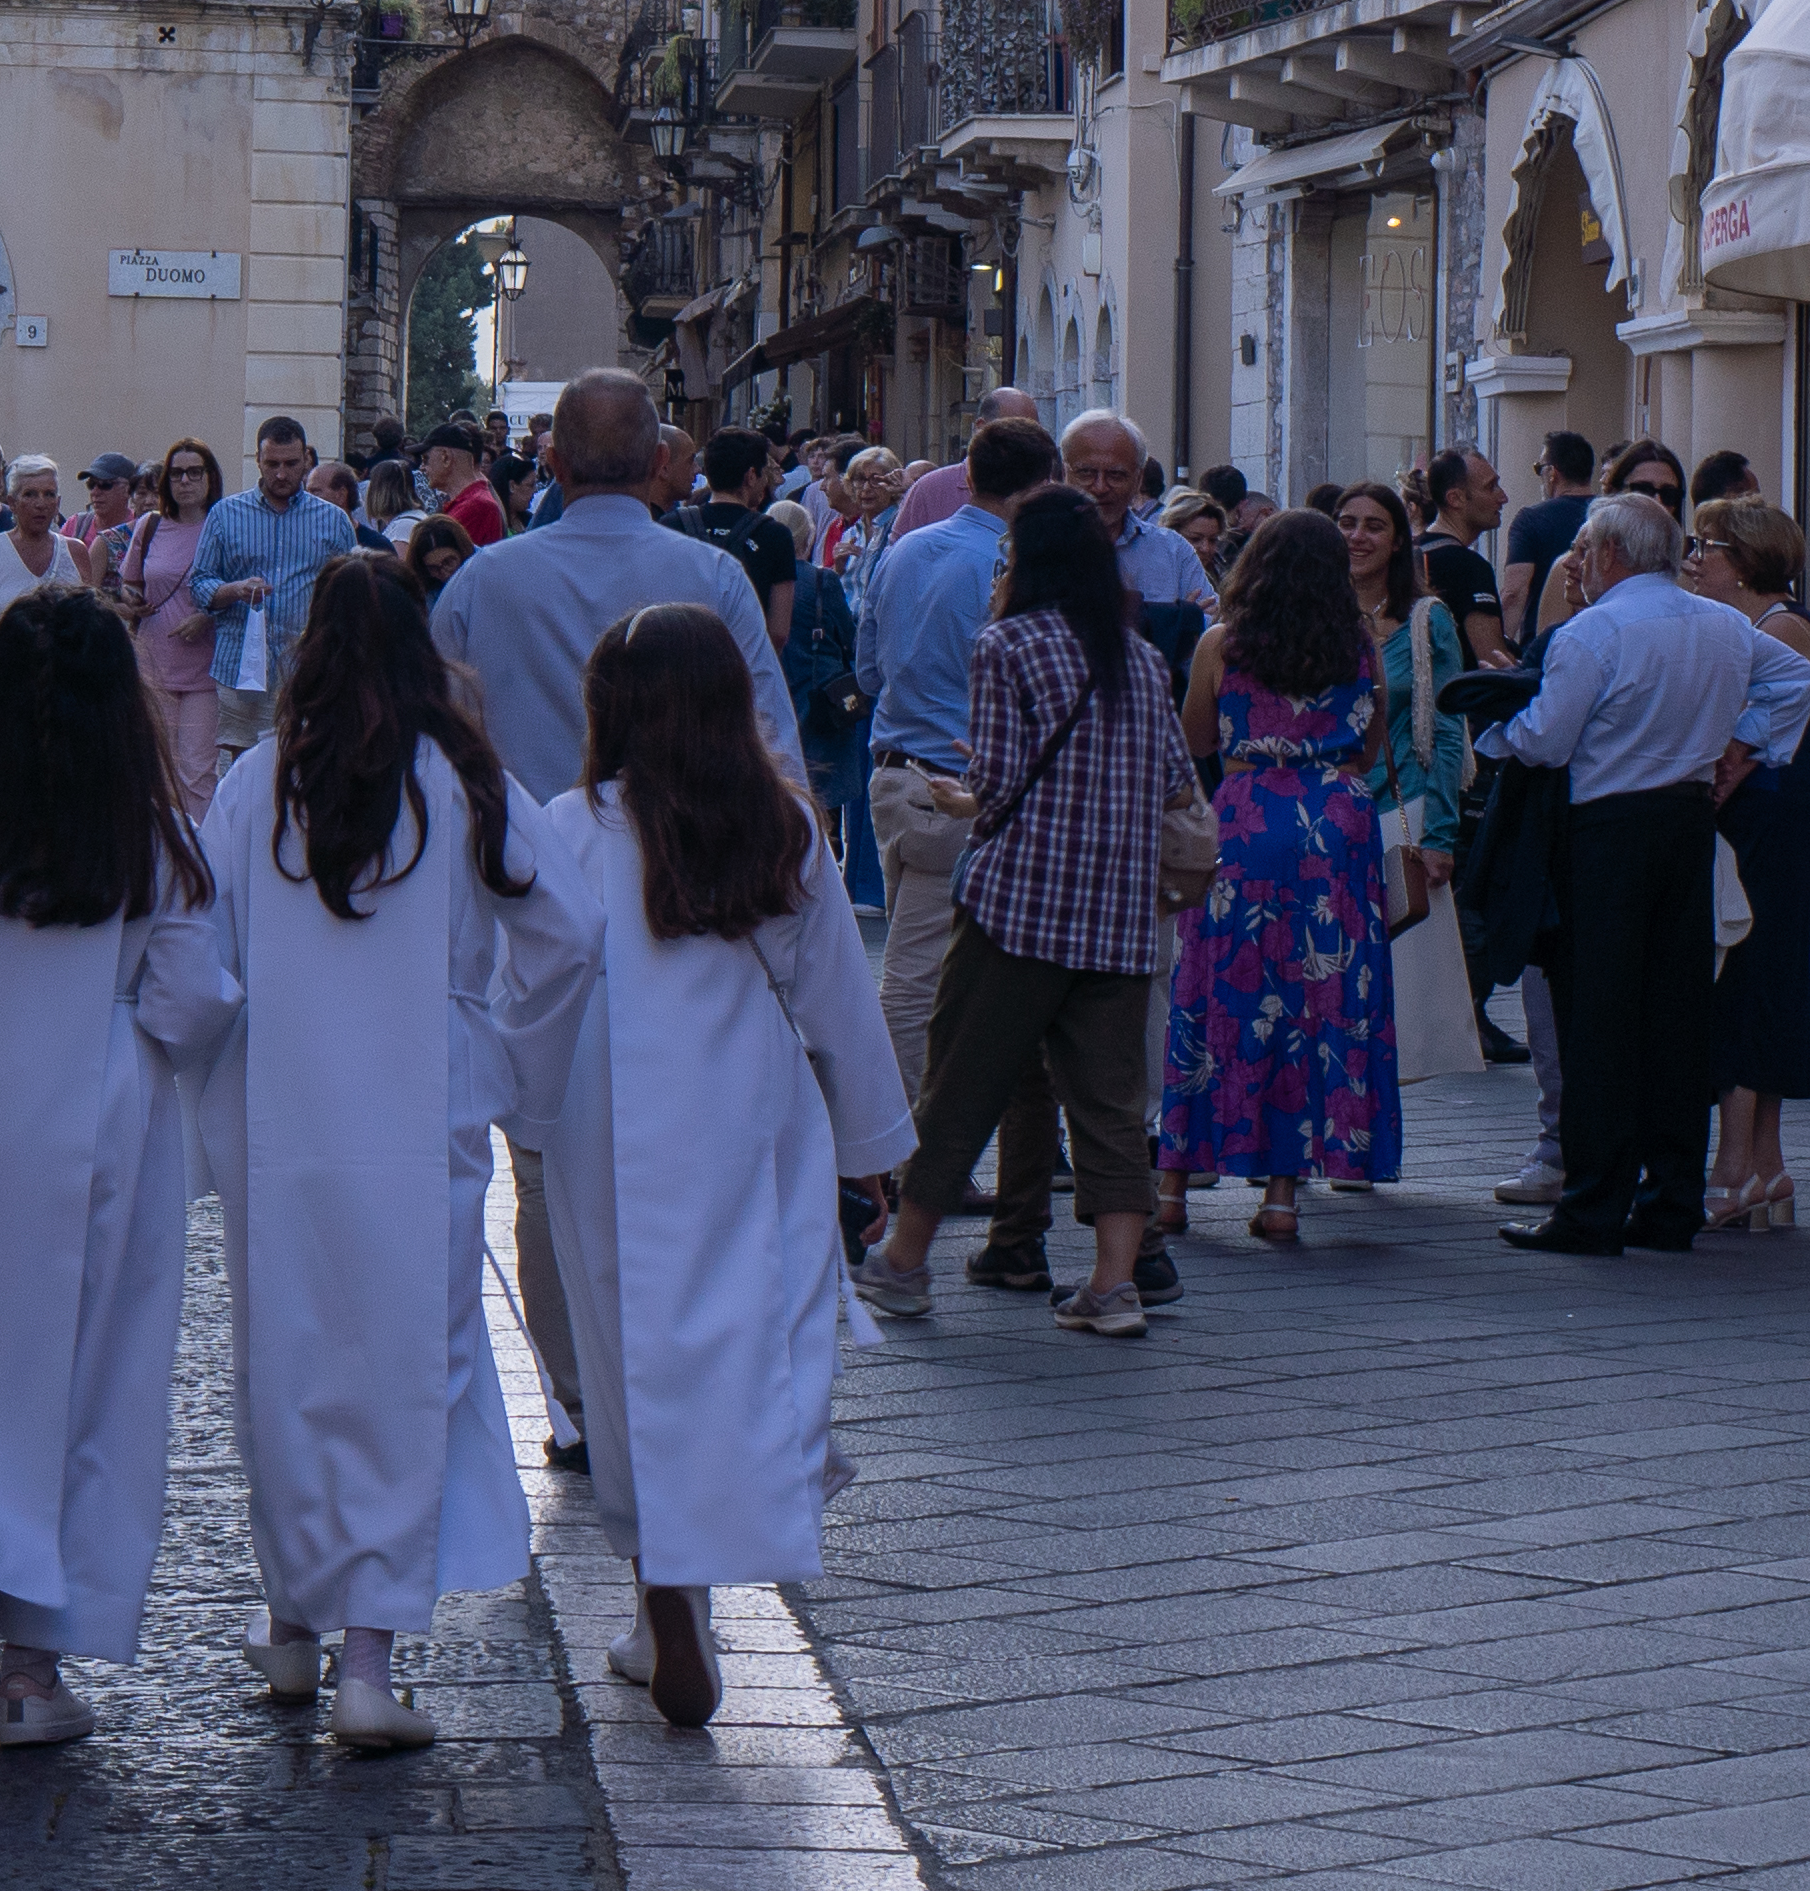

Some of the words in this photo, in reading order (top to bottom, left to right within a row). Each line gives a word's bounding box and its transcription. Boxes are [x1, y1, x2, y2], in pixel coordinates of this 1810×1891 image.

[119, 255, 159, 266] PIAZZA
[145, 268, 206, 283] DUOMO
[27, 324, 37, 339] 9
